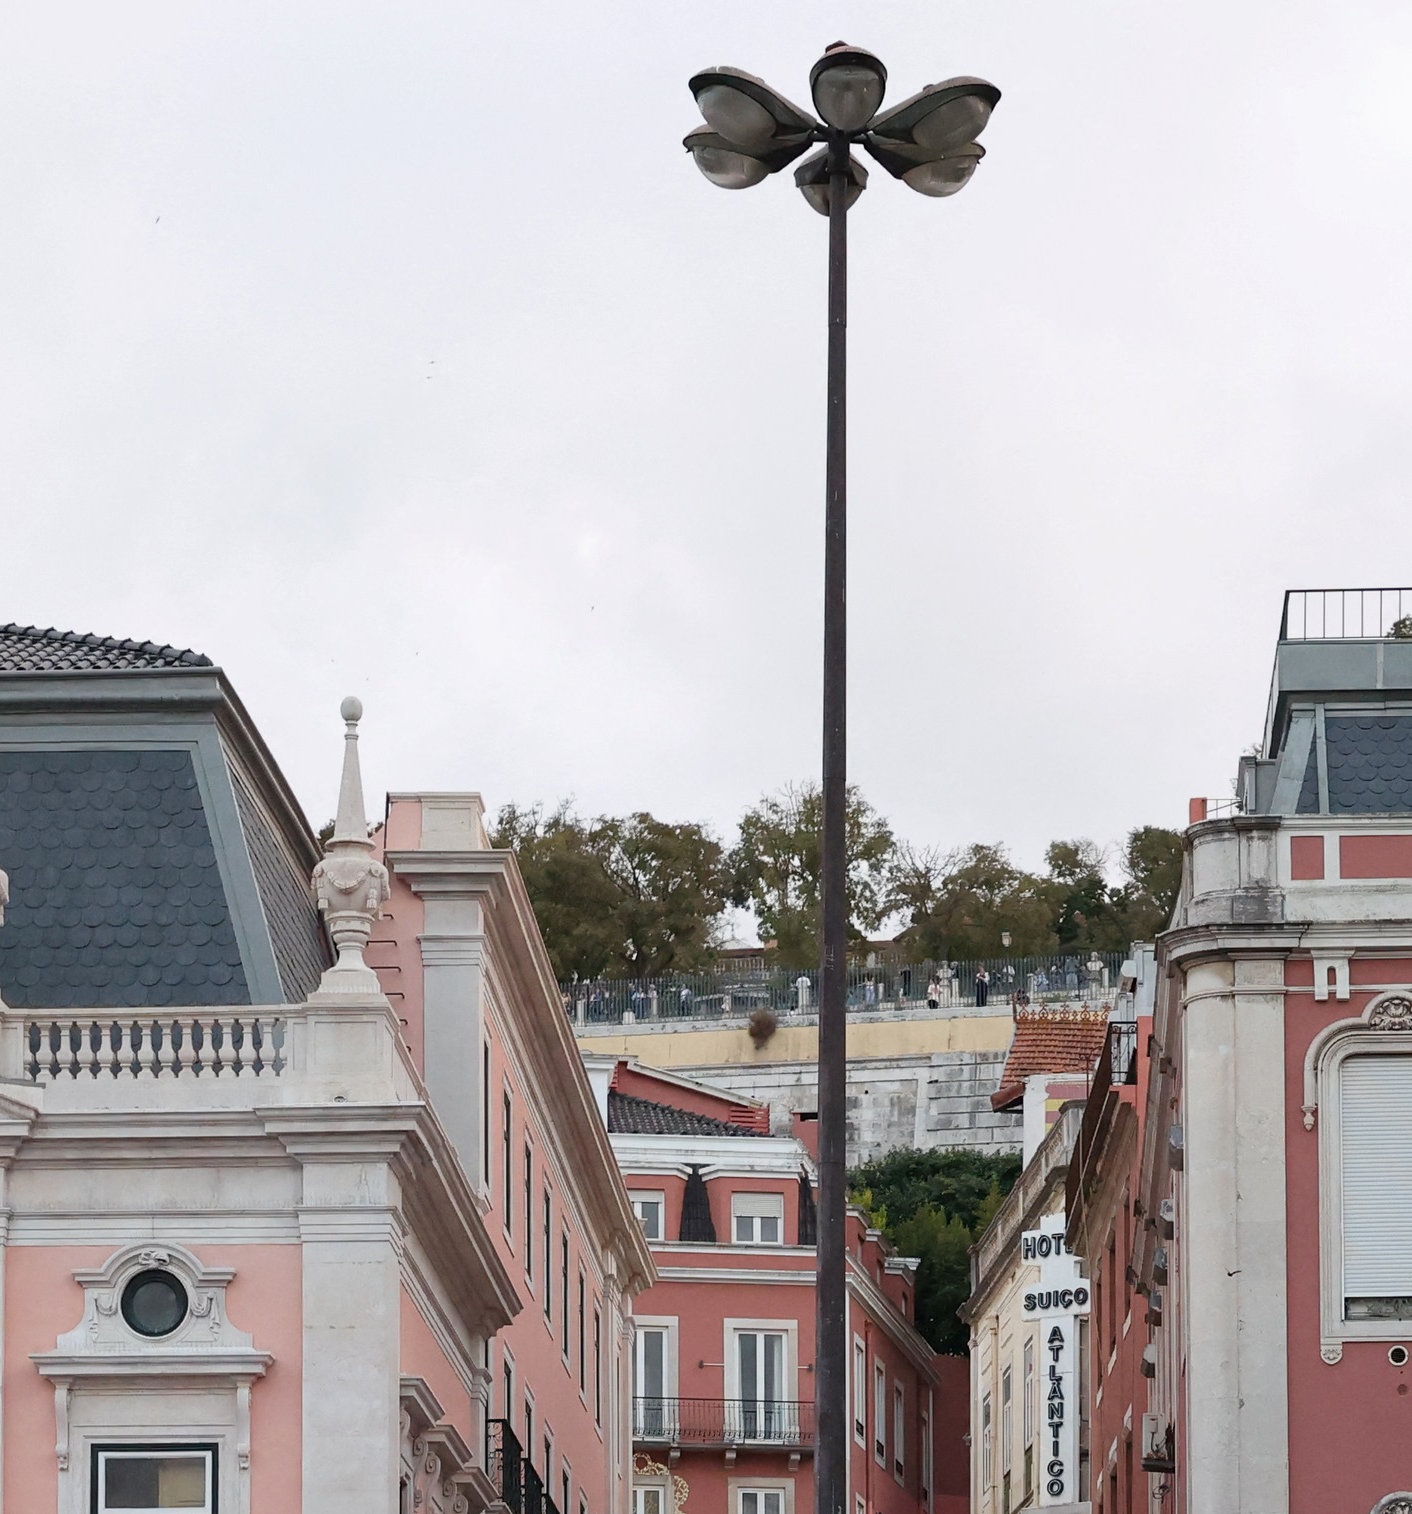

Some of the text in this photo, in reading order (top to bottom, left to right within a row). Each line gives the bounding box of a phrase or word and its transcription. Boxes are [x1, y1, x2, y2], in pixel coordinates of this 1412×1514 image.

[1022, 1233, 1075, 1259] HOT
[1024, 1287, 1089, 1311] SUIÇO
[1047, 1325, 1064, 1496] ATLÂNTICO
